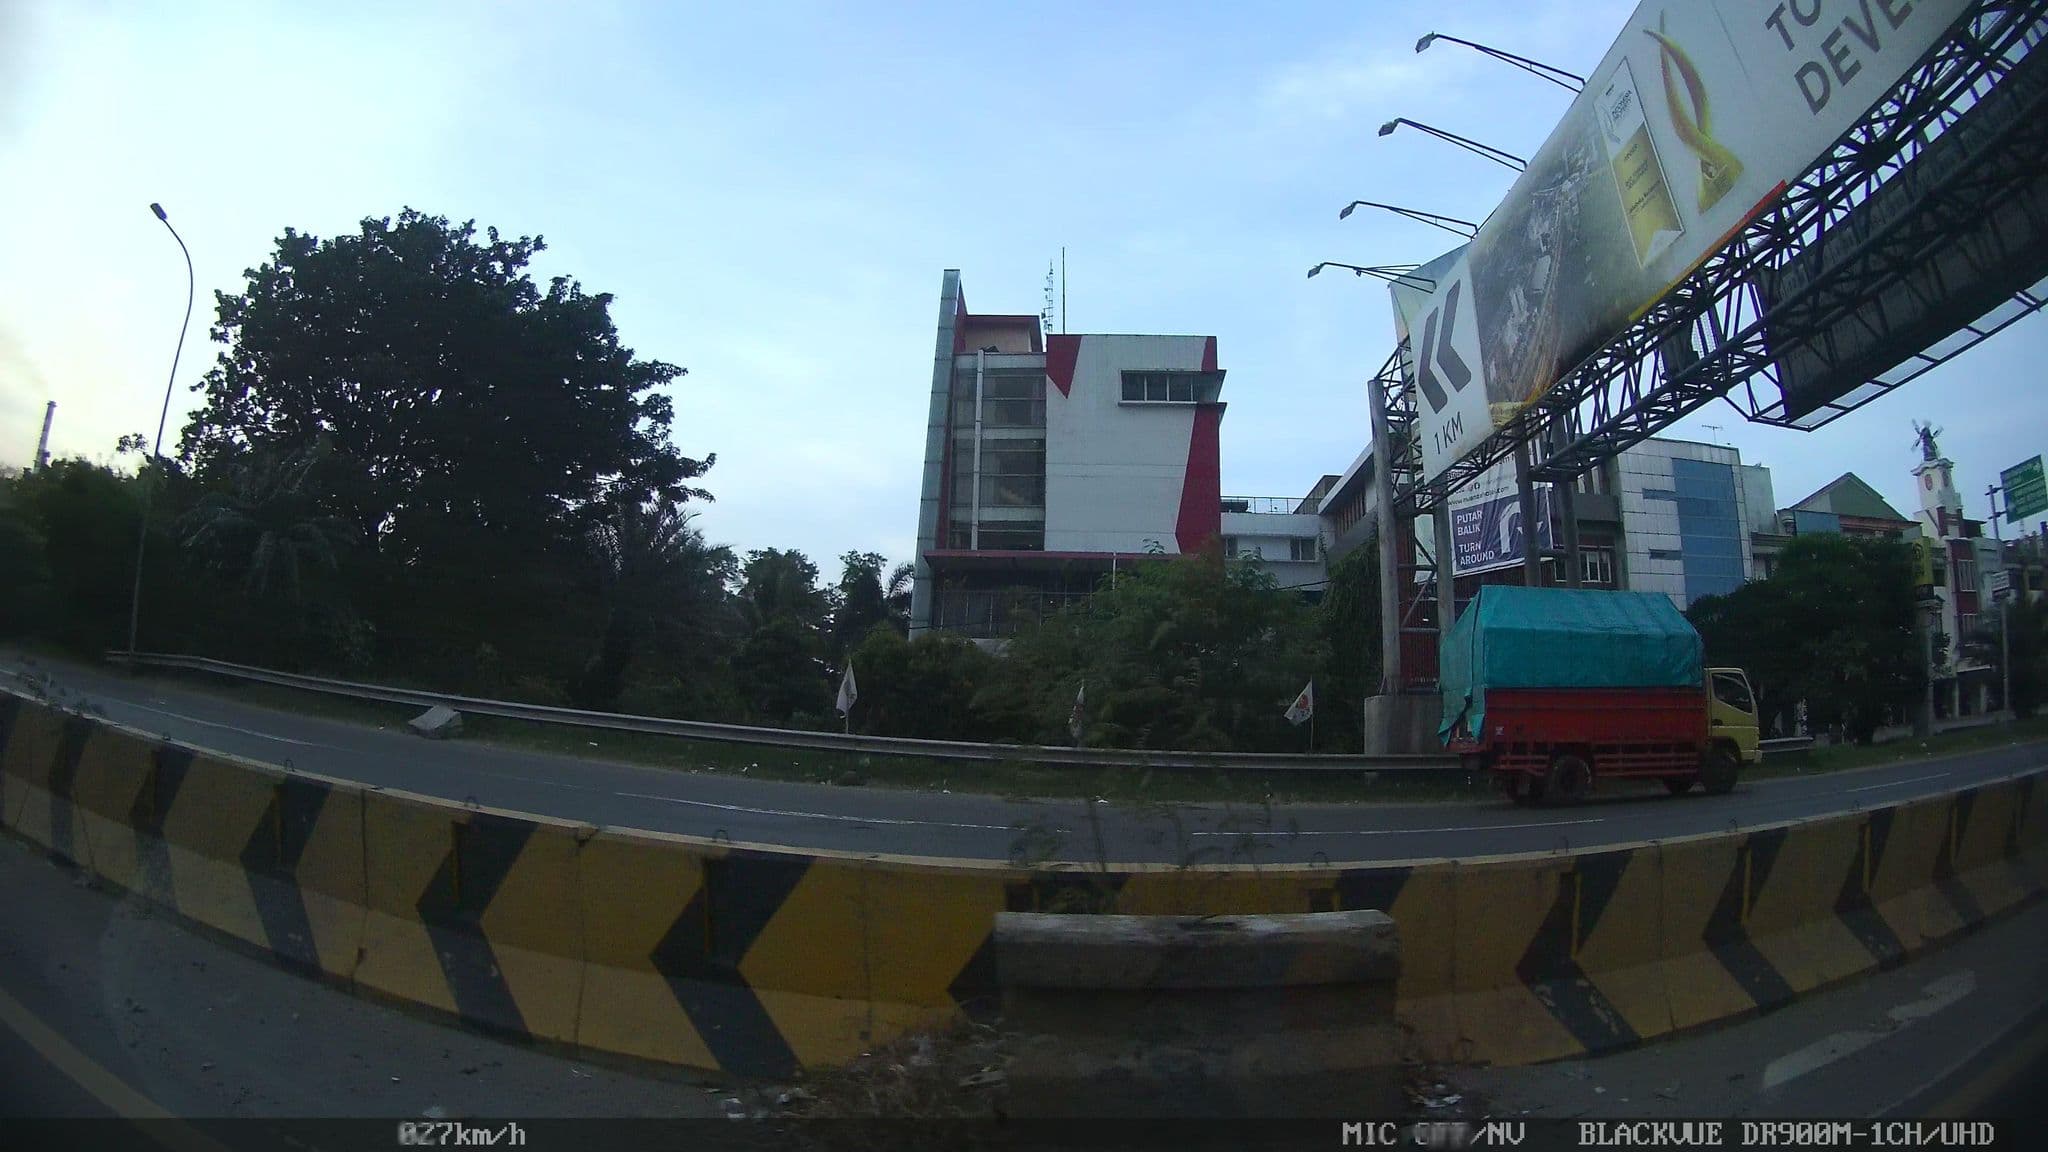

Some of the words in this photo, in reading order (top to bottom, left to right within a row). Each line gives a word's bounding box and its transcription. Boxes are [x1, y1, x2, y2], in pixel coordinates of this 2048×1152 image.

[1434, 432, 1441, 454] 1
[1442, 411, 1463, 448] KM
[1456, 510, 1483, 524] PUTAR
[1457, 523, 1480, 536] BALIK
[1458, 540, 1481, 553] TURN
[1460, 550, 1495, 565] AROUND
